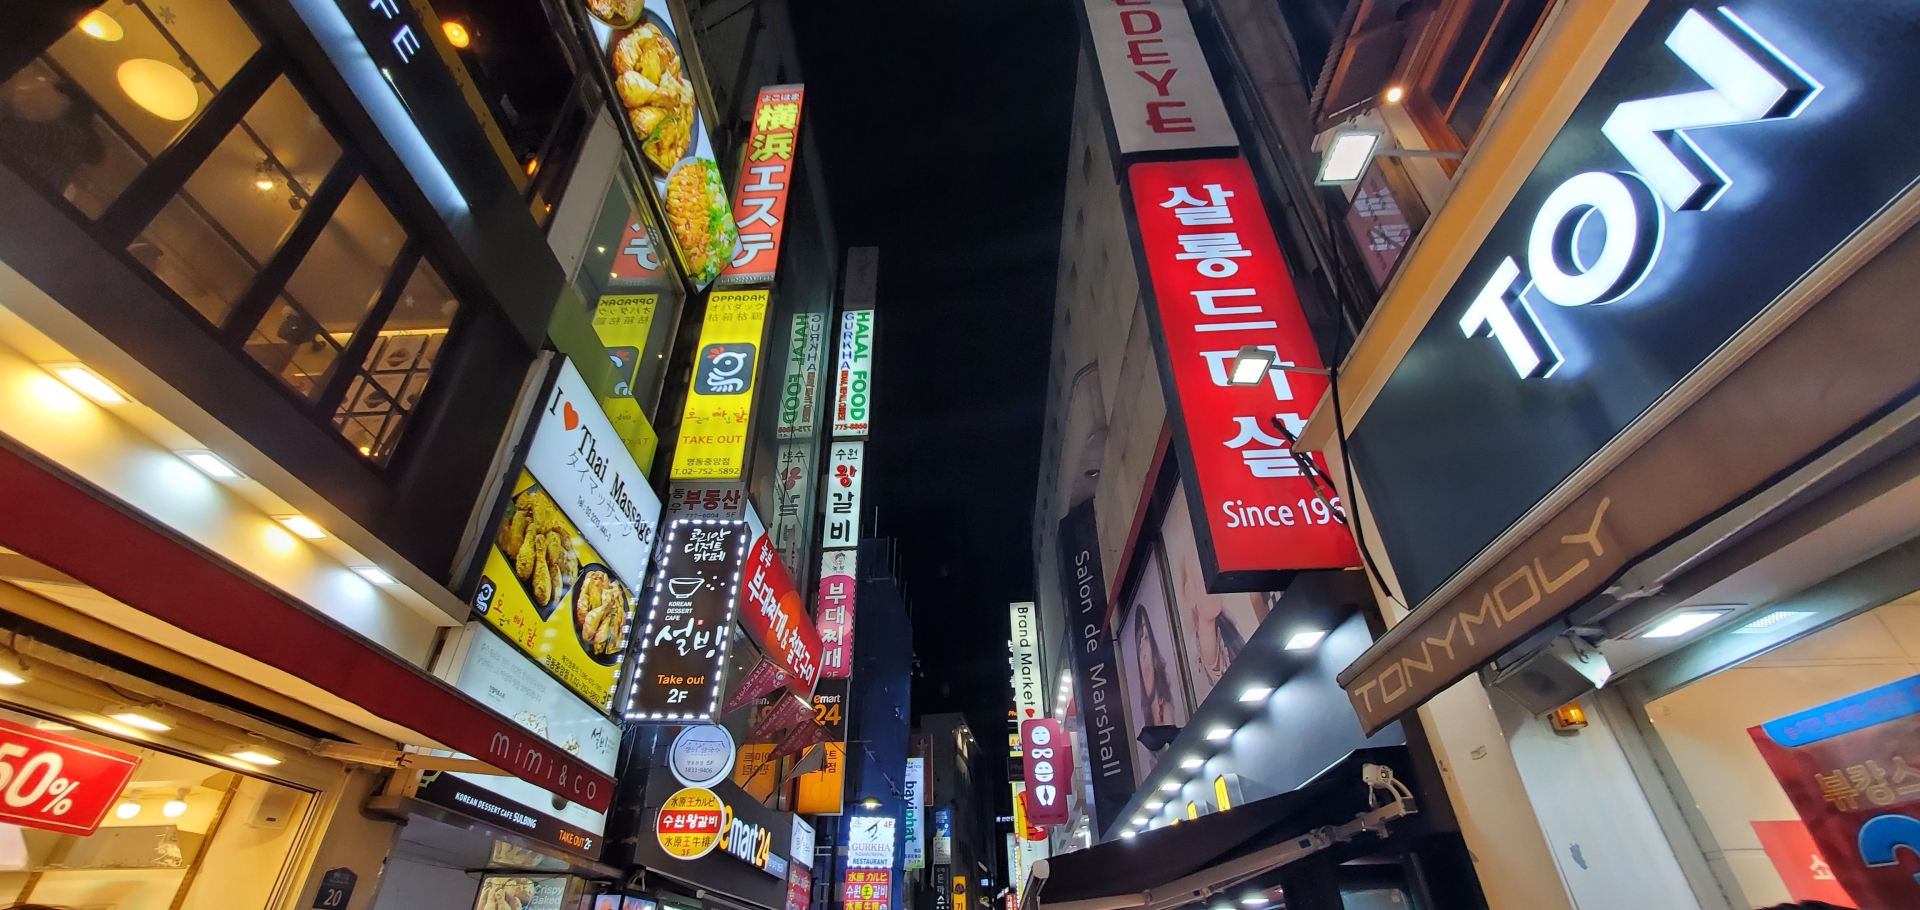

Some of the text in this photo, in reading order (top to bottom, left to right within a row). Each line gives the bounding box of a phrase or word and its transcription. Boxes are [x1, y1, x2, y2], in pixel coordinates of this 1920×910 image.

[761, 93, 800, 102] よこはま
[731, 103, 799, 268] 横浜エステ
[1459, 7, 1824, 379] TON
[712, 294, 766, 303] OPPADAK
[840, 312, 855, 370] GURKHA
[850, 312, 871, 421] HALAL FOOD
[549, 387, 564, 416] I
[683, 435, 743, 444] TAKE OUT
[687, 457, 730, 466] 명동중앙점
[835, 448, 858, 461] 수원
[674, 468, 740, 476] T.02-752-5892
[566, 450, 632, 537] タイマッサージ
[577, 425, 609, 483] Thai
[610, 472, 652, 545] Massage
[683, 489, 741, 511] 부동산
[830, 464, 858, 542] 왕갈비
[1222, 499, 1294, 527] Since
[690, 528, 731, 541] 코리안
[684, 542, 723, 553] 디저트
[693, 551, 726, 562] 카페
[1354, 496, 1610, 713] TONYMOLY
[822, 582, 847, 668] 부대찌개
[654, 618, 723, 658] 설빙
[545, 653, 570, 680] 명동중앙점
[1017, 607, 1036, 707] Brand Market
[1074, 549, 1121, 777] Salon de Marshall
[656, 674, 705, 685] Take out
[667, 689, 689, 704] 2F
[813, 694, 841, 703] emart
[815, 703, 842, 726] 24
[591, 727, 609, 754] 설빙
[489, 731, 597, 800] mimi&co
[0, 743, 80, 816] 50%
[455, 791, 537, 829] KOREAN DESSERT CAFE SULBING
[663, 814, 718, 829] 수원왕갈비
[883, 821, 893, 829] 4F
[559, 829, 592, 851] TAKE OUT 2F
[664, 836, 711, 848] 水原王牛排
[719, 805, 772, 869] emart24
[851, 843, 891, 852] GURKHA
[323, 888, 342, 907] 20
[531, 895, 562, 905] Baked
[535, 885, 564, 896] Crispy
